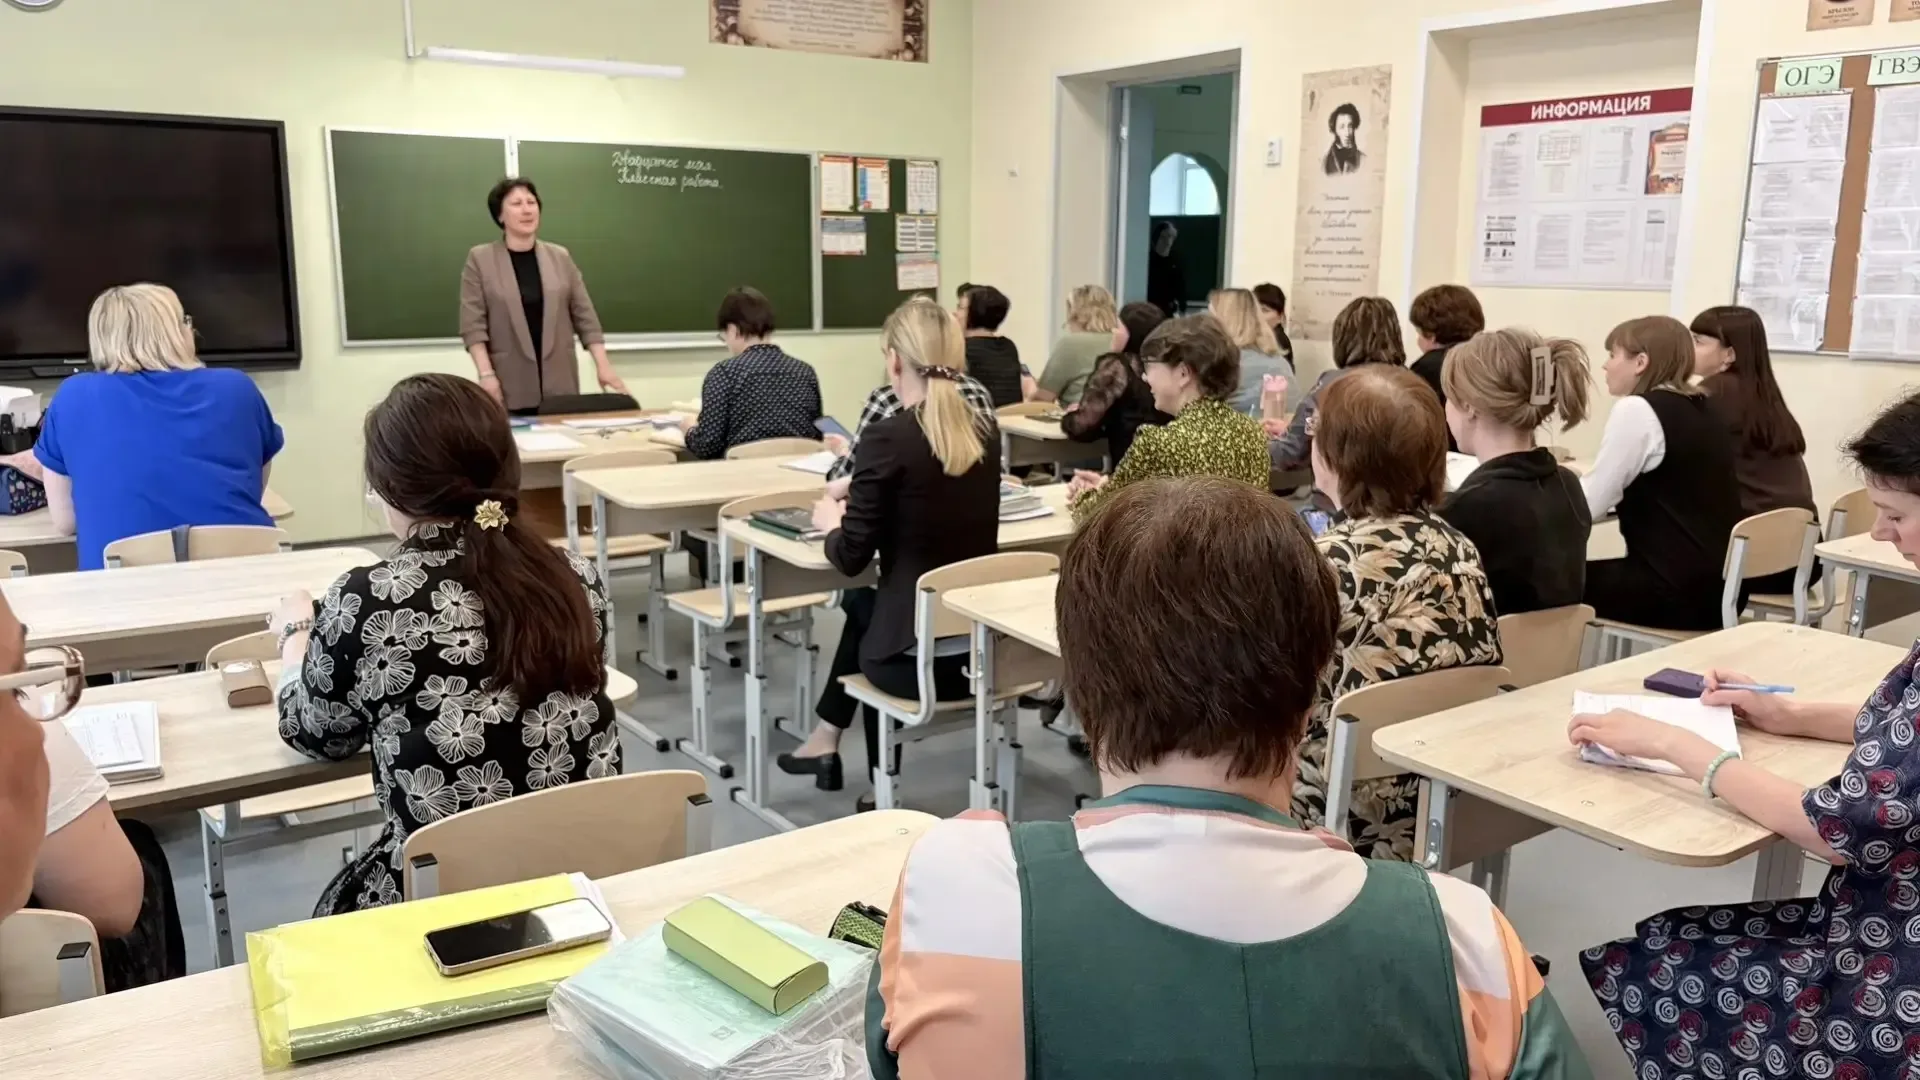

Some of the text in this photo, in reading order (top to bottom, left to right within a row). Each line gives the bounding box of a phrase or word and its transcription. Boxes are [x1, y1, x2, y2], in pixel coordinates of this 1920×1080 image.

[1784, 64, 1835, 87] ОГЭ
[1876, 55, 1920, 76] ГВЭ
[1530, 95, 1652, 121] ИНФОРМАЦИЯ
